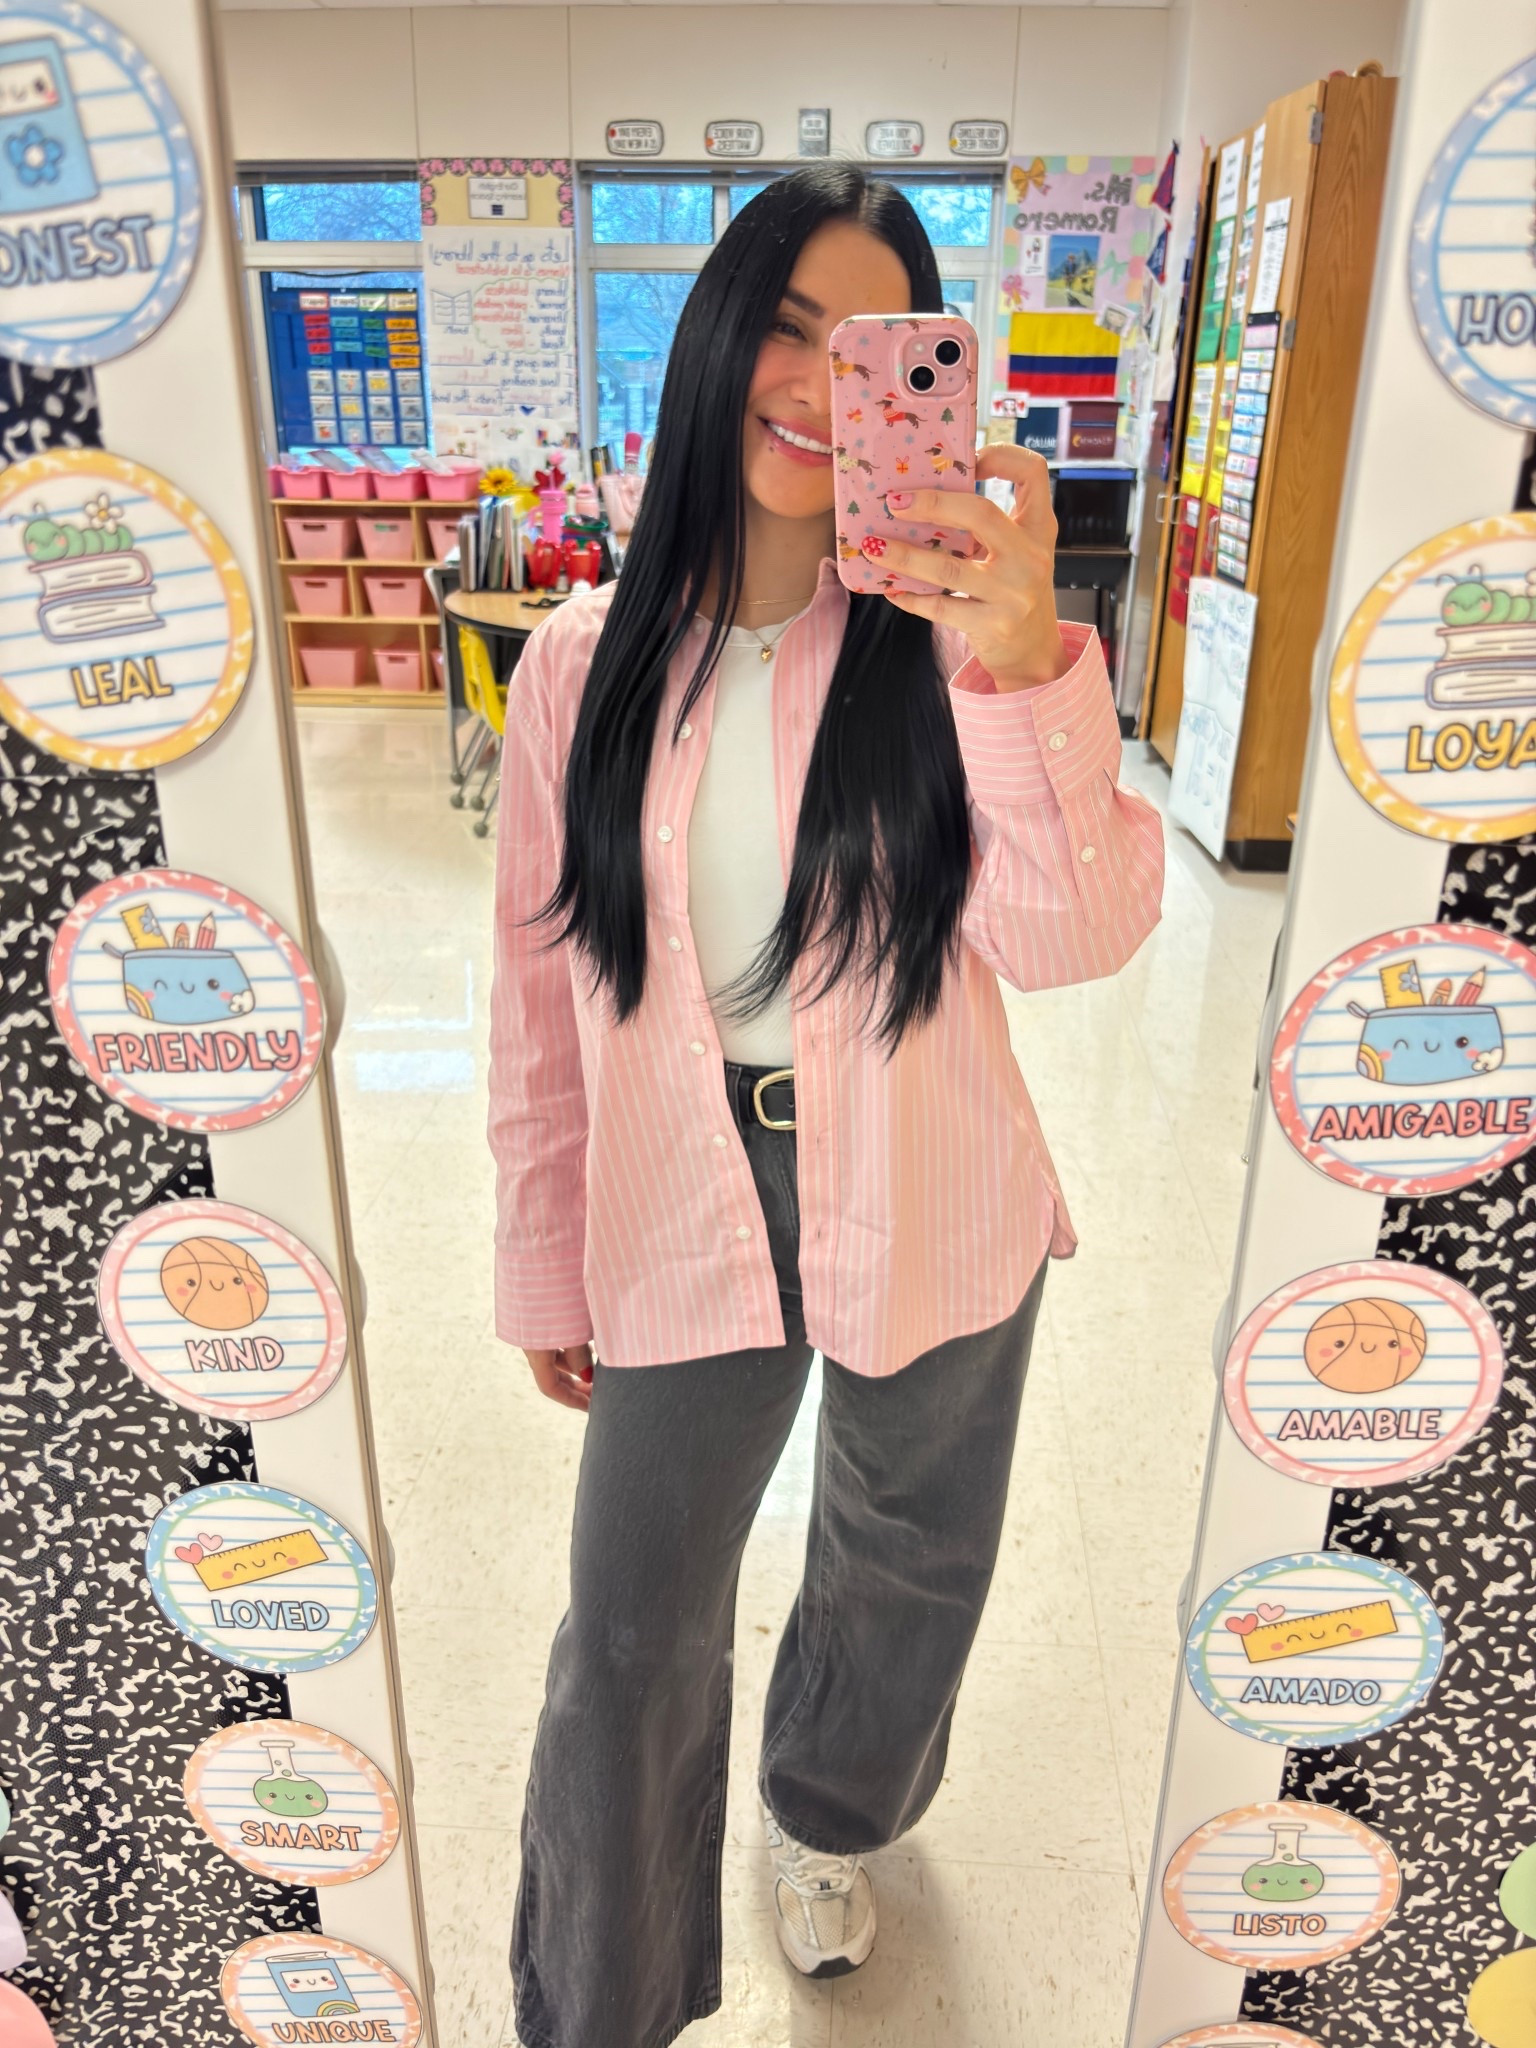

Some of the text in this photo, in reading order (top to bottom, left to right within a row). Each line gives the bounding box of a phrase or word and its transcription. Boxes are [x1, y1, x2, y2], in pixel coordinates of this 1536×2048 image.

[1458, 292, 1536, 347] HO
[70, 655, 174, 709] LEAL
[93, 1030, 301, 1073] FRIENDLY
[1310, 1097, 1532, 1143] AMIGABLE
[185, 1336, 284, 1372] KIND
[1277, 1408, 1442, 1441] AMABLE
[211, 1599, 330, 1631] LOVED
[1240, 1676, 1381, 1706] AMADO
[240, 1820, 362, 1851] SMART
[1233, 1913, 1327, 1936] LISTO
[271, 2019, 397, 2044] UNIQUE
